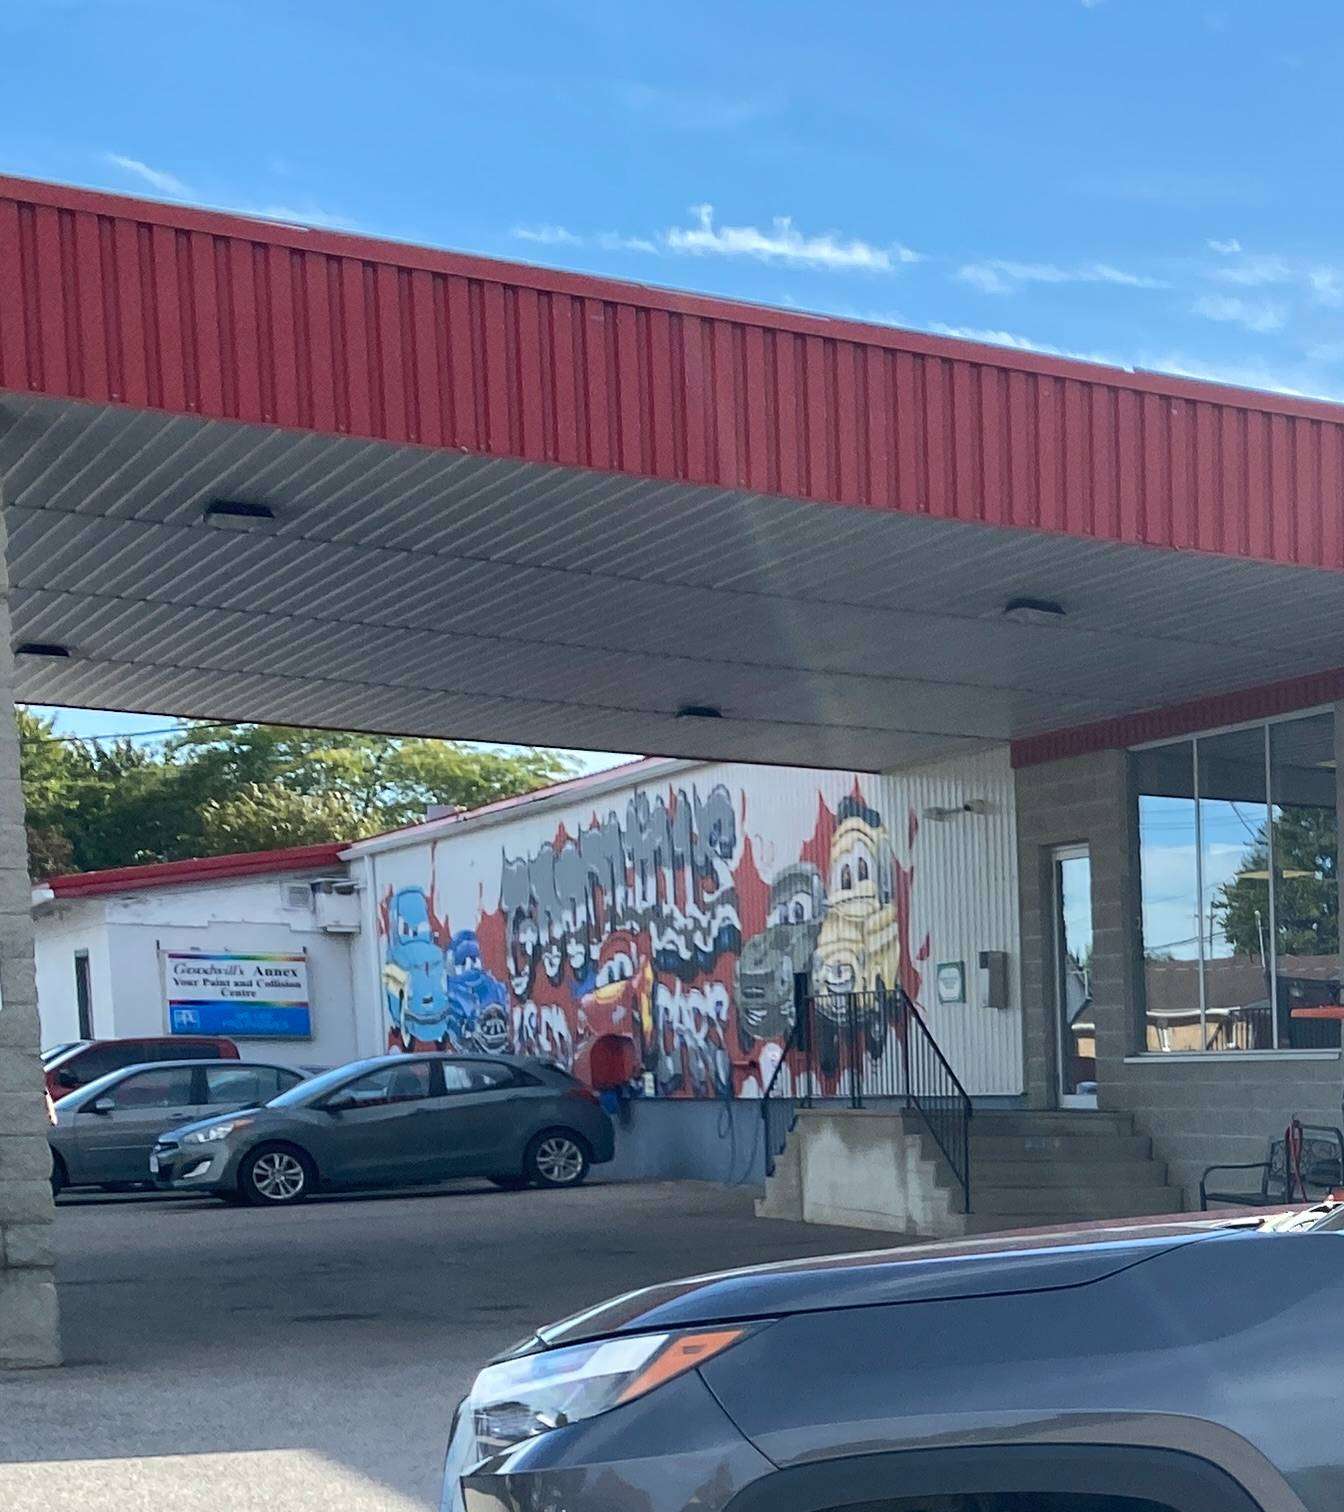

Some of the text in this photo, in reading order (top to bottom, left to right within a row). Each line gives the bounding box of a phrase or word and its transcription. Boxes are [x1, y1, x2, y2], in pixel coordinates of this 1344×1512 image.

[253, 965, 298, 977] Annex
[173, 977, 302, 989] Your Paint and Collision
[220, 989, 257, 998] Centre
